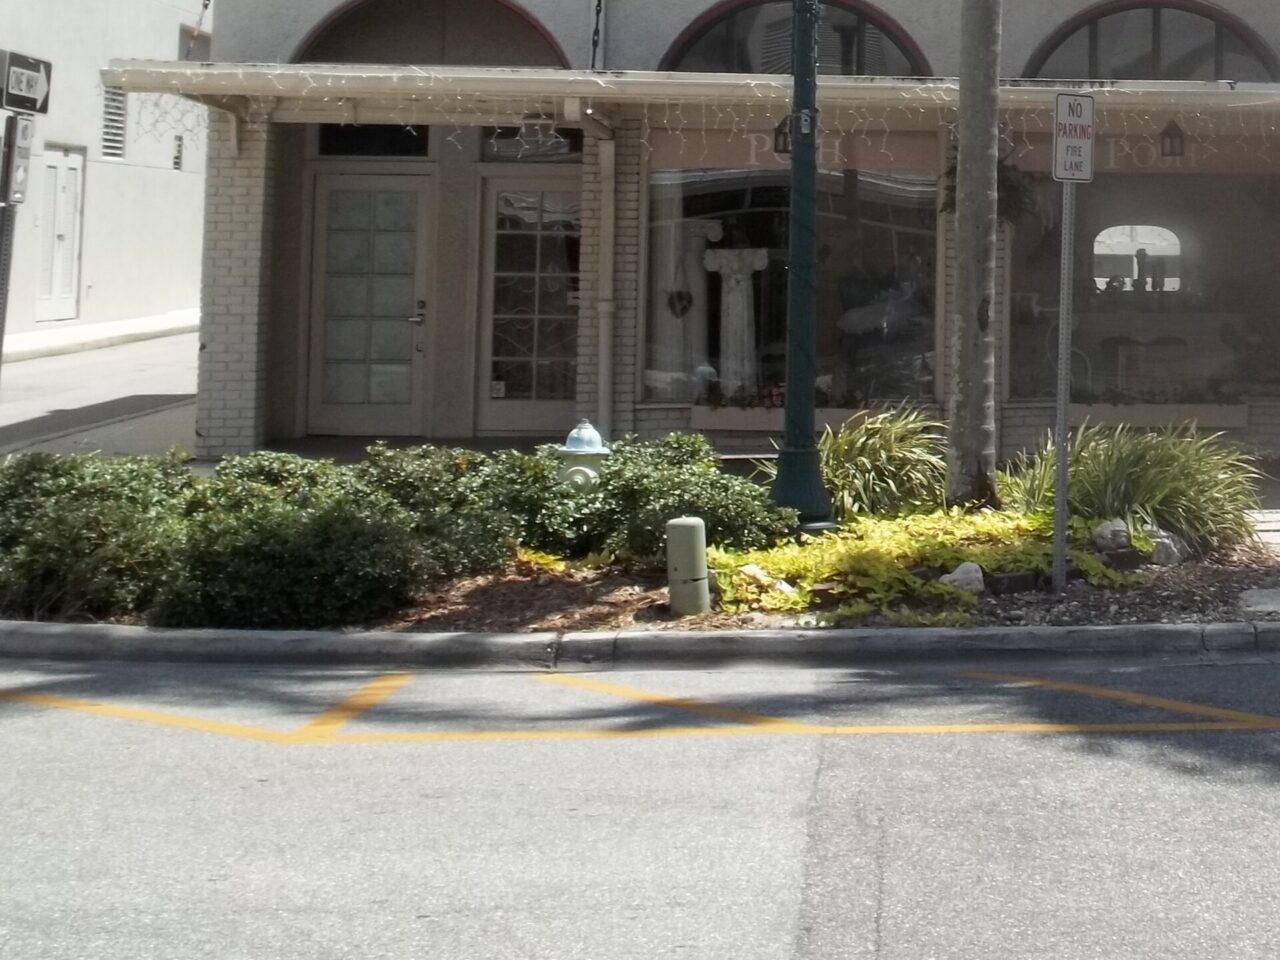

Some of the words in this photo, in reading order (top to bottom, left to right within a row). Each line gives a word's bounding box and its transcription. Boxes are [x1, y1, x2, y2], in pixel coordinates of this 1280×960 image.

[1068, 102, 1082, 118] NO
[1058, 122, 1092, 140] PARKING
[745, 133, 841, 166] PH
[1066, 145, 1082, 157] FIRE
[1064, 160, 1083, 172] LANE
